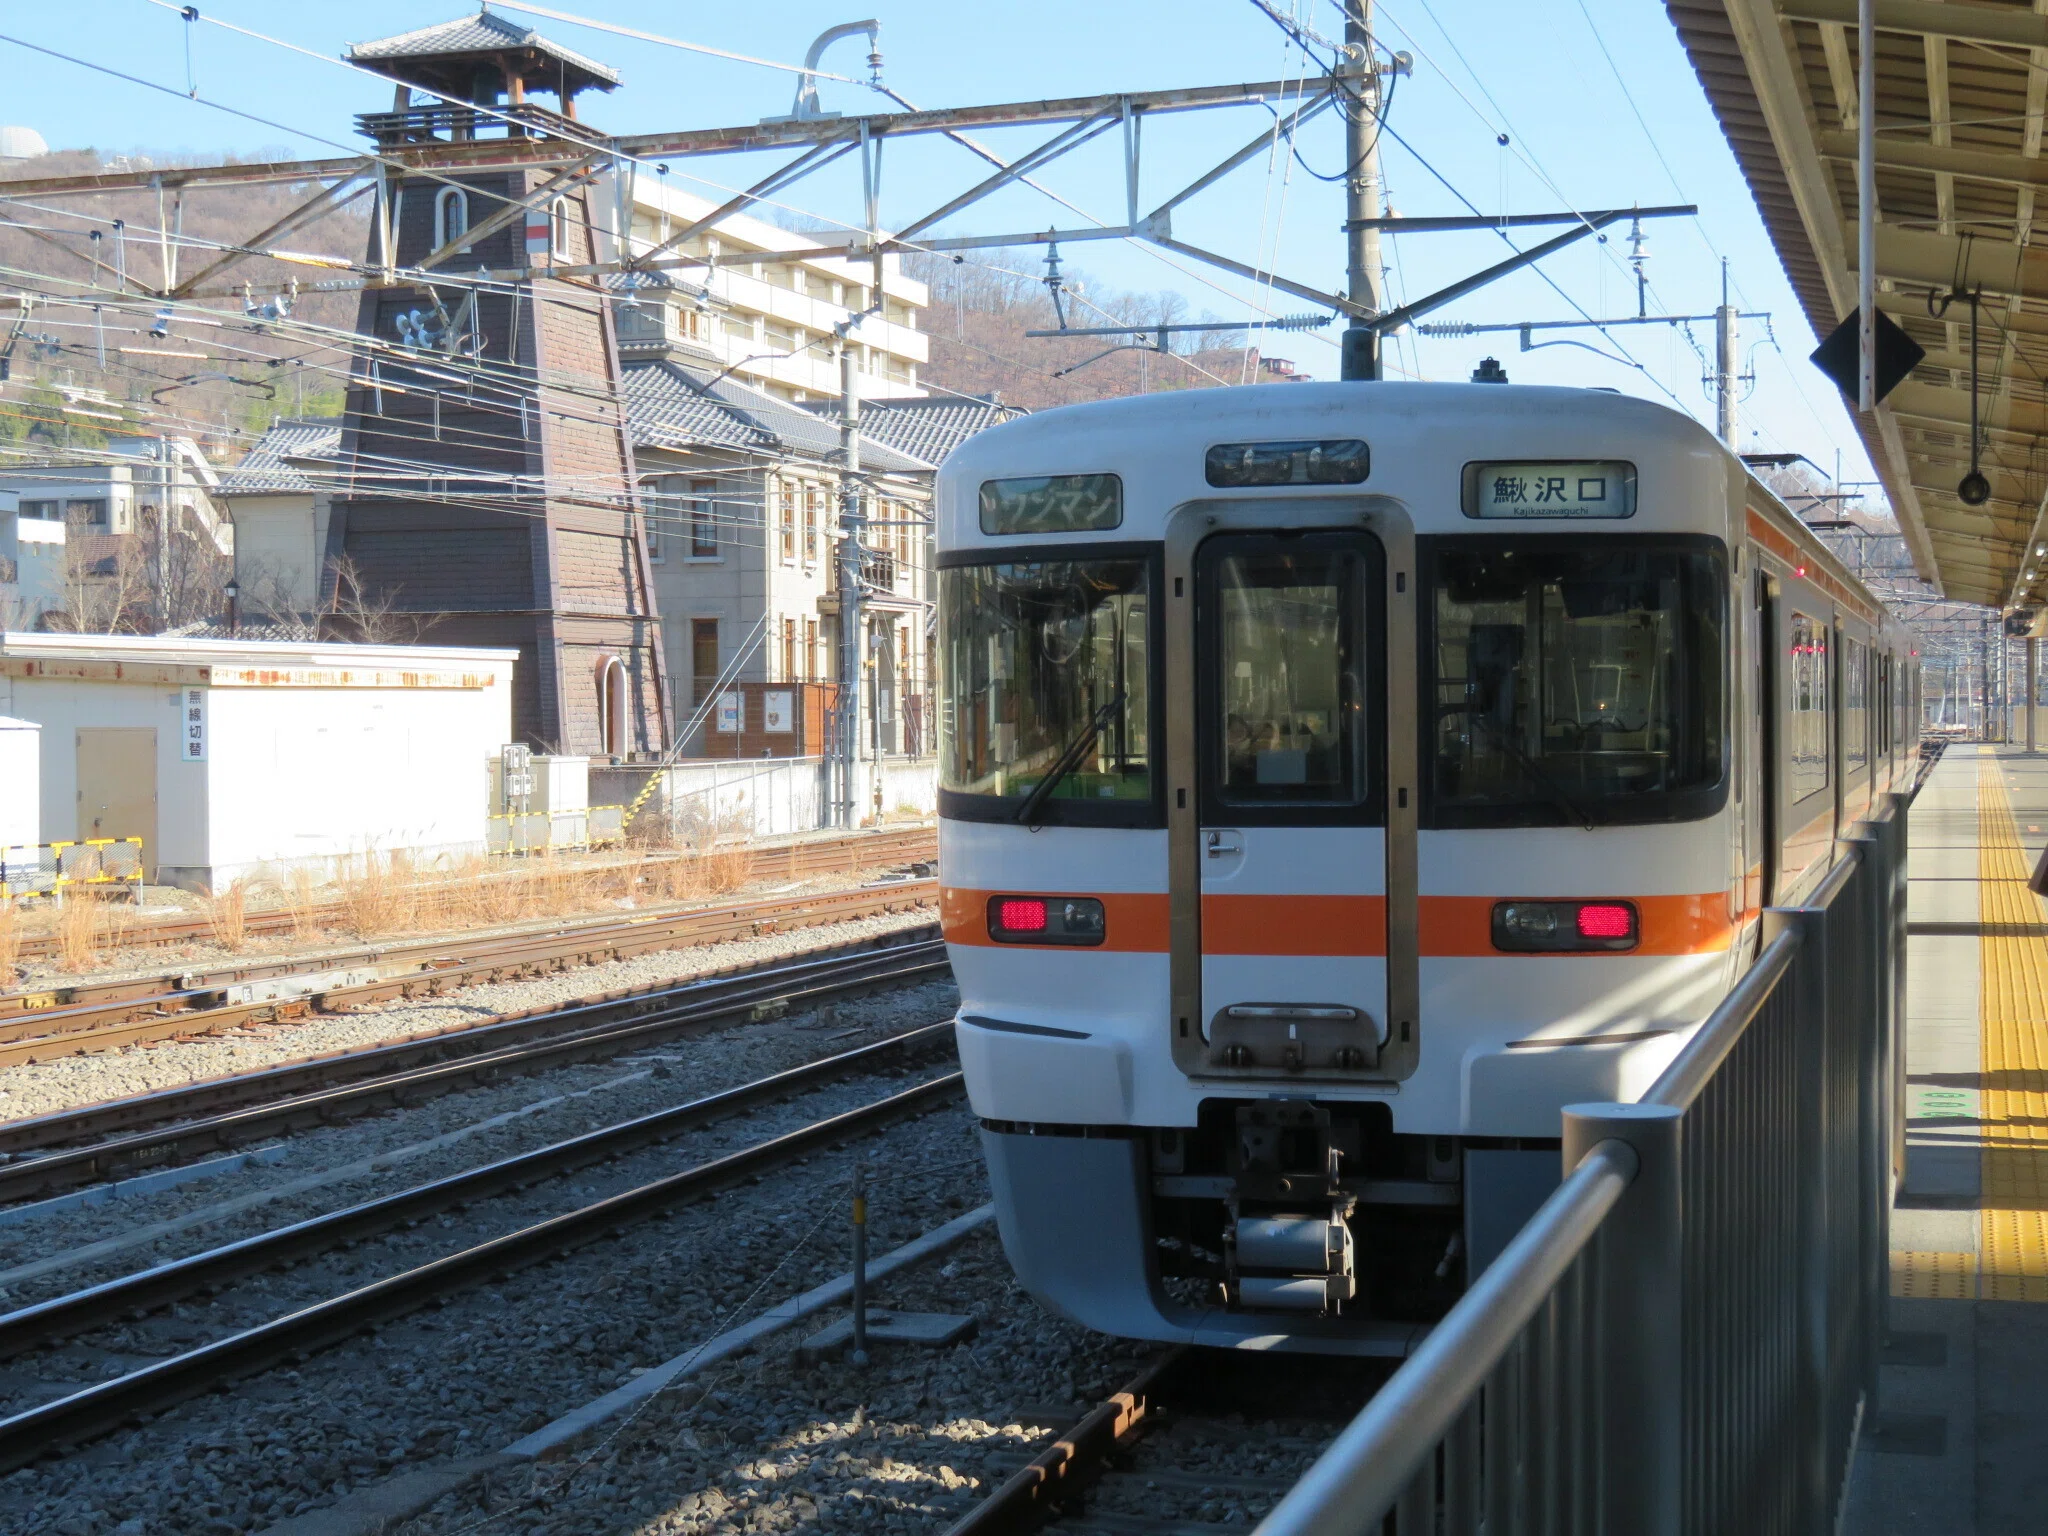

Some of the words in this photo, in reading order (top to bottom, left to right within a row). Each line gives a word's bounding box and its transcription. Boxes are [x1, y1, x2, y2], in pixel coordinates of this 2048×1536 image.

[1493, 476, 1606, 503] 鰍沢口
[1513, 506, 1589, 518] Kajikazawaguchi
[188, 690, 202, 757] 無線切替
